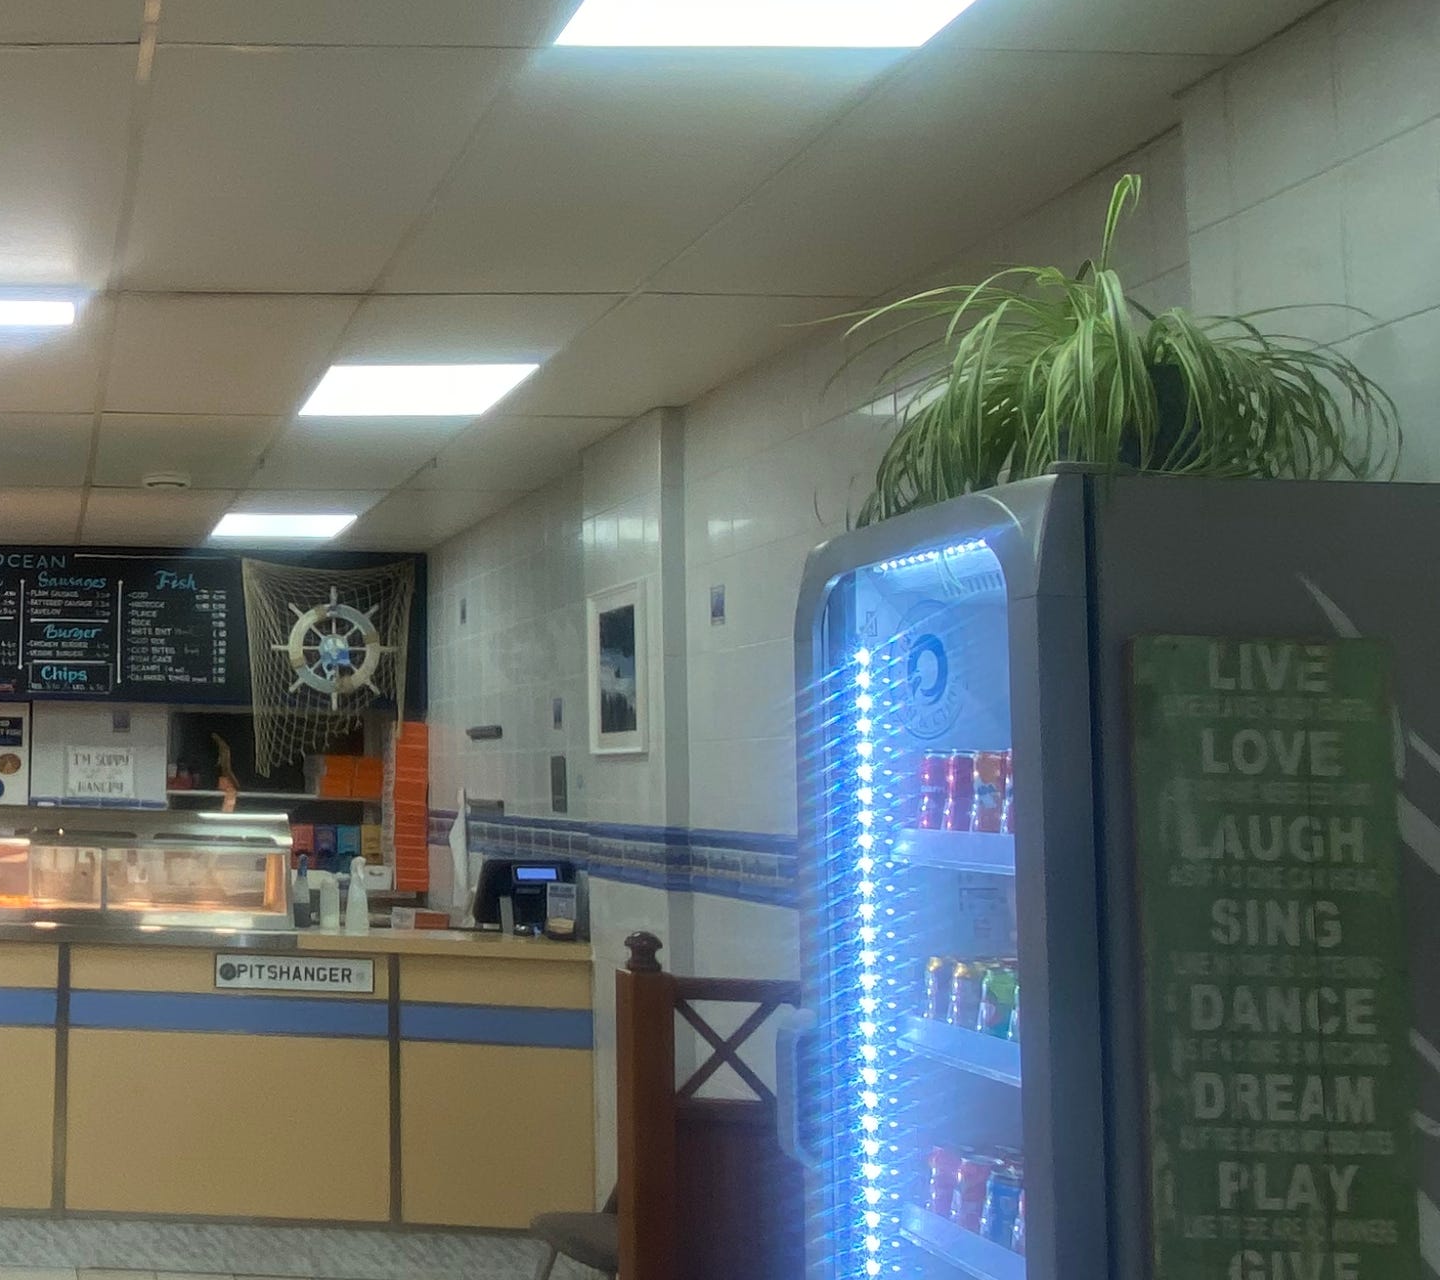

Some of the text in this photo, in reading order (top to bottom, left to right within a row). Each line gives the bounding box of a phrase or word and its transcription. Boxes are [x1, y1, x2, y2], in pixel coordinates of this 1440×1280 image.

[37, 571, 107, 590] Sausages
[154, 570, 198, 591] Fish
[43, 624, 102, 640] Burger
[41, 665, 88, 683] Chips
[1210, 643, 1329, 692] LIVE
[1201, 728, 1344, 776] LOVE
[1180, 815, 1365, 862] LAUGH
[1211, 899, 1342, 948] SING
[237, 963, 352, 983] PITSHANGER
[1190, 984, 1377, 1035] DANCE
[1191, 1072, 1376, 1123] DREAM
[1219, 1161, 1359, 1212] PLAY
